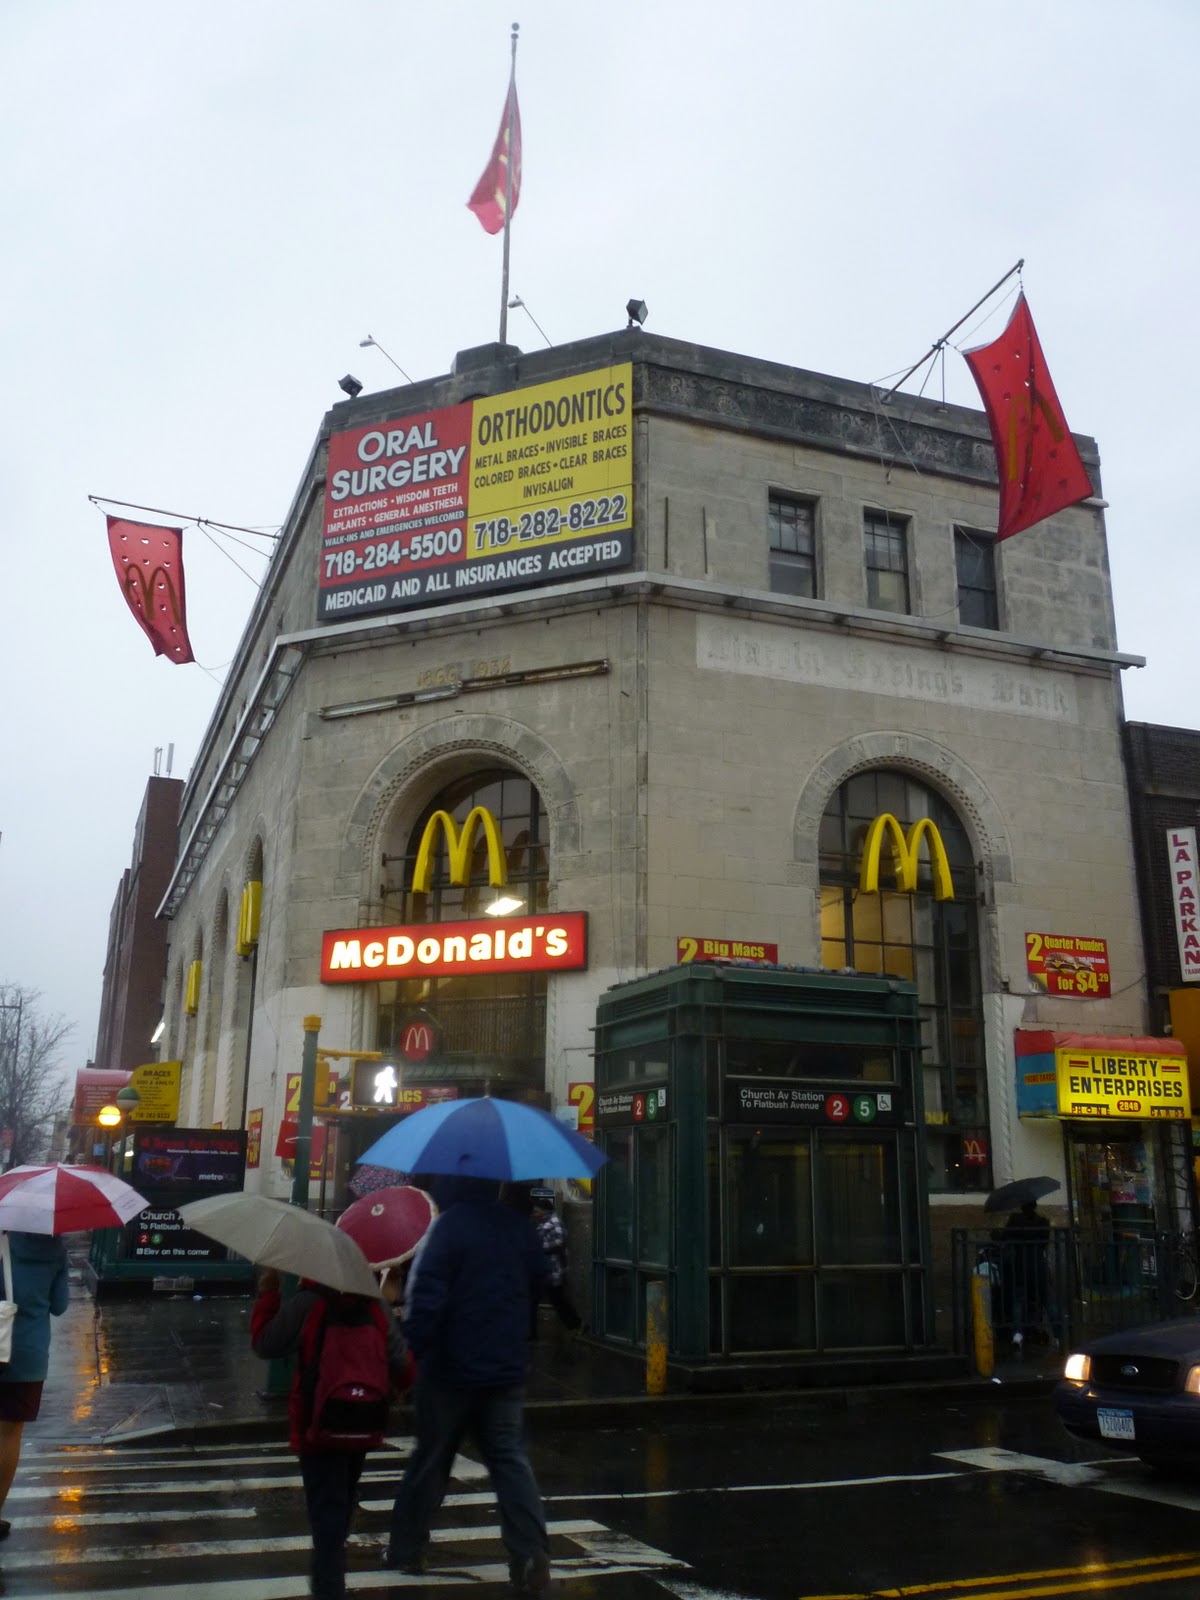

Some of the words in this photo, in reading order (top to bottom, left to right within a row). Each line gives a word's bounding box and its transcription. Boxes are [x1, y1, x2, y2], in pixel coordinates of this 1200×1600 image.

[478, 382, 626, 446] ORTHODONTICS
[358, 422, 438, 462] ORAL
[475, 452, 504, 470] METAL
[506, 444, 539, 462] BRACES
[546, 433, 588, 454] INVISIBLE
[592, 424, 627, 443] BRACES
[330, 446, 465, 500] SURGERY
[474, 470, 514, 488] COLORED
[518, 461, 550, 479] BRACES
[560, 453, 587, 470] CLEAR
[592, 444, 627, 463] BRACES
[334, 498, 388, 518] EXTRACTIONS
[396, 489, 430, 505] WISDOM
[432, 482, 458, 496] TEETH
[523, 476, 574, 498] INVISALIGN
[324, 530, 358, 547] WALK-INS
[360, 528, 374, 540] AND
[376, 519, 422, 536] EMERGENCIES
[424, 510, 464, 526] WELCOMED
[328, 516, 366, 534] IMPLANTS
[374, 509, 410, 523] GENERAL
[412, 496, 463, 514] ANESTHESIA
[473, 494, 626, 550] 718-282-8222
[324, 528, 462, 578] 718-284-5500
[325, 584, 386, 610] MEDICAID
[392, 578, 420, 598] AND
[426, 572, 450, 592] ALL
[456, 554, 542, 587] INSURANCES
[548, 540, 622, 570] ACCEPTED
[1172, 834, 1191, 863] LA
[1176, 870, 1200, 965] PARKAN
[330, 926, 568, 970] McDonald's
[680, 938, 698, 964] 2
[704, 940, 728, 956] Big
[732, 942, 764, 958] Macs
[1026, 934, 1044, 962] 2
[1044, 936, 1074, 950] Quarter
[1076, 938, 1104, 952] Pounders
[1058, 976, 1074, 990] for
[1091, 1057, 1158, 1077] LIBERTY
[571, 1084, 594, 1124] 2
[740, 1089, 774, 1100] Church
[778, 1090, 789, 1100] Av
[791, 1092, 824, 1102] Station
[754, 1100, 788, 1109] Flatbush
[790, 1101, 820, 1110] Avenue
[1070, 1076, 1182, 1098] ENTERPRISES
[636, 1100, 641, 1115] 2
[649, 1099, 655, 1114] 5
[833, 1100, 843, 1116] 2
[860, 1102, 870, 1116] 5
[1071, 1106, 1110, 1116] PHONE
[1150, 1109, 1184, 1118] CARDS
[140, 1211, 175, 1220] Church
